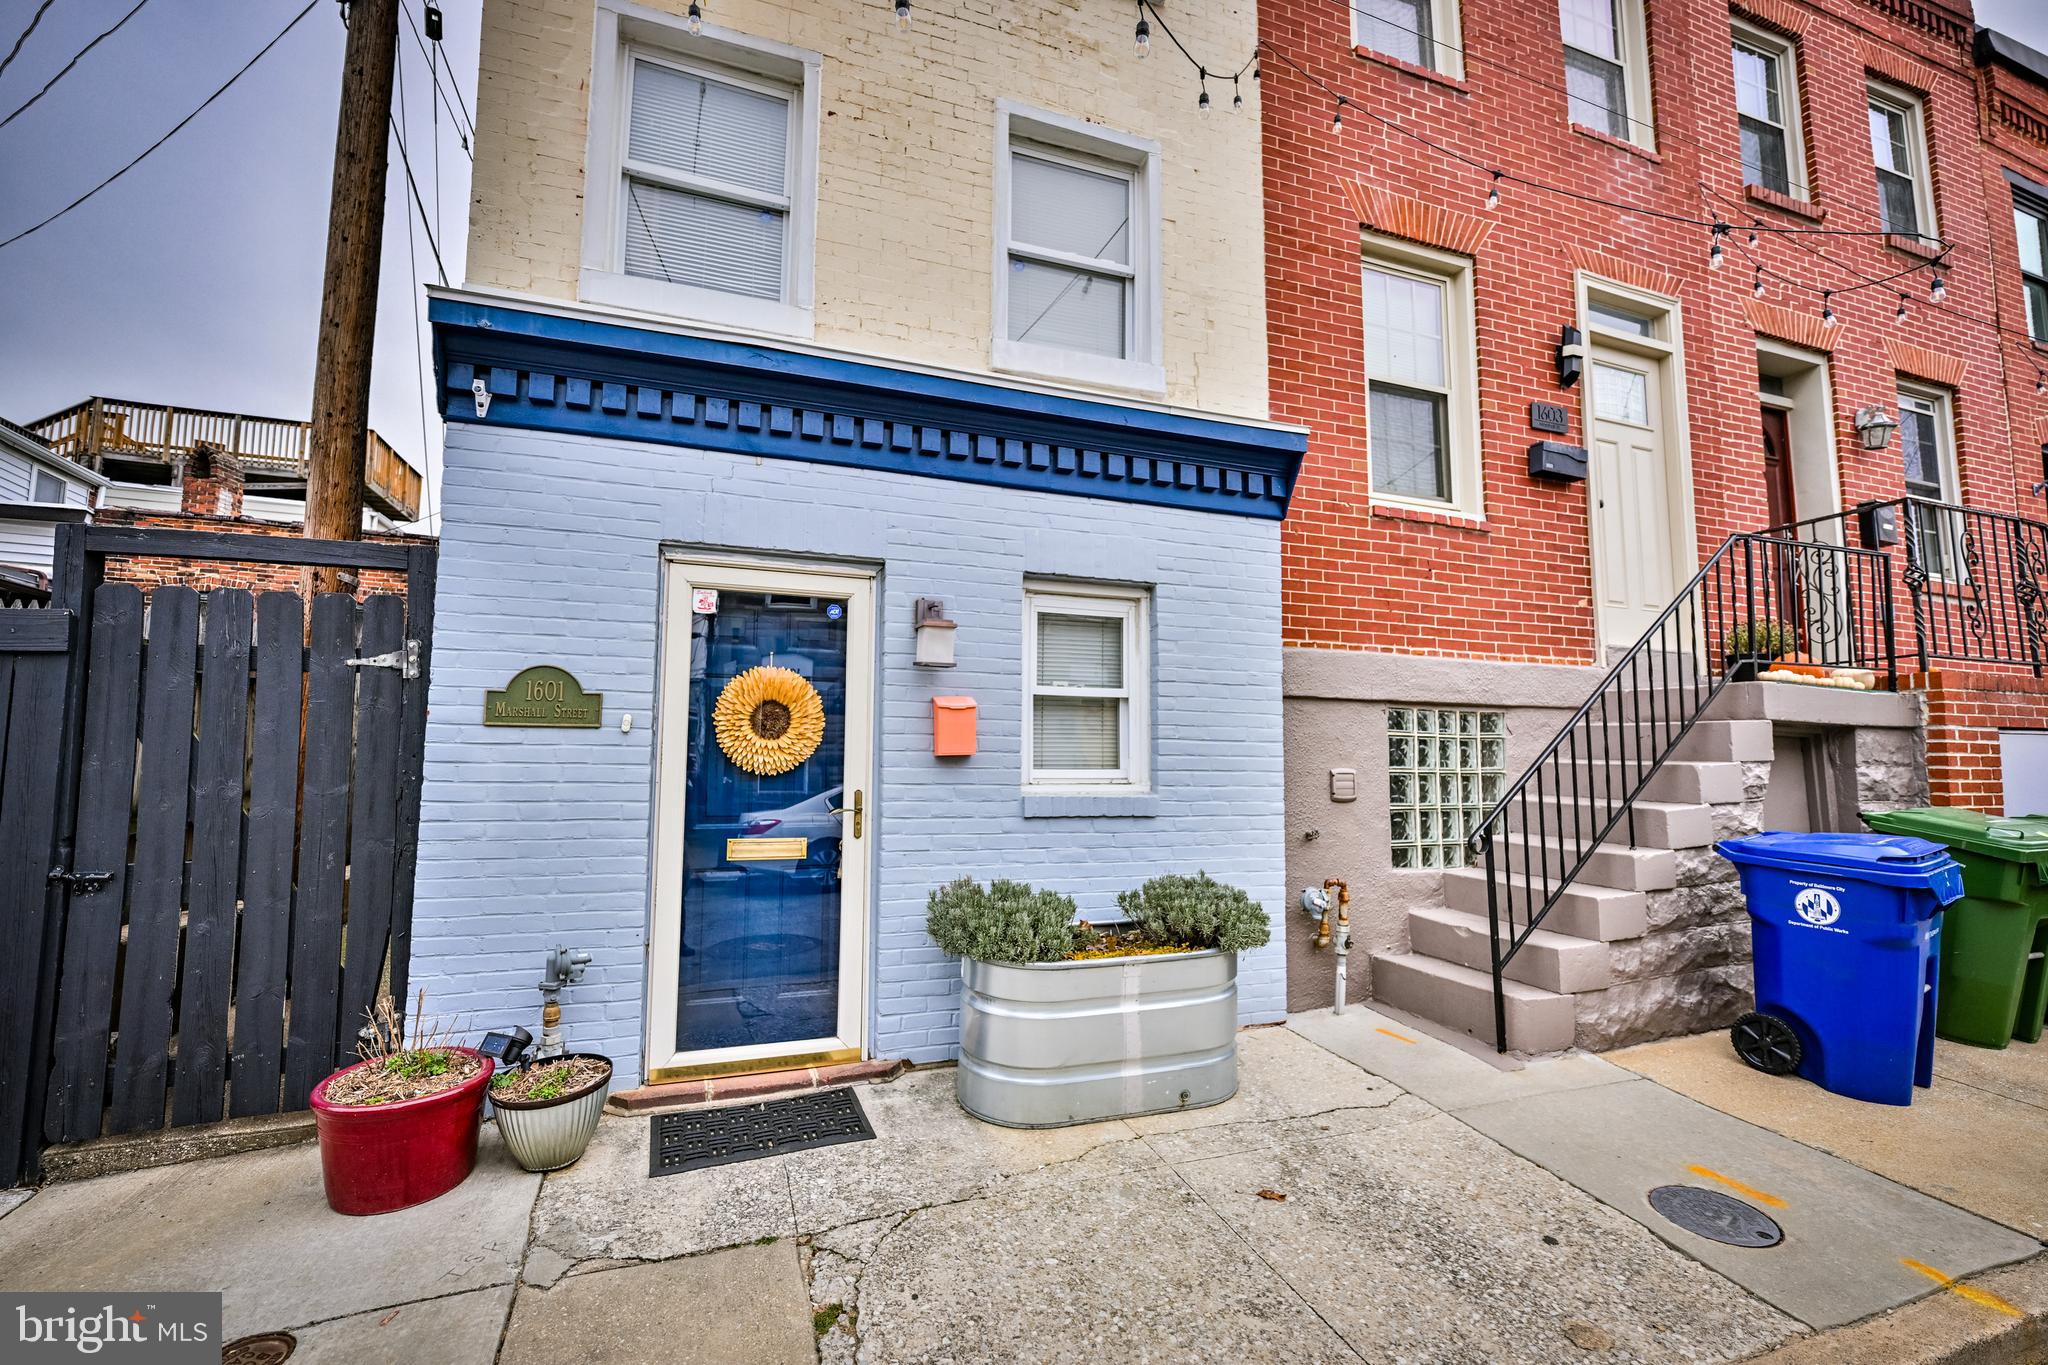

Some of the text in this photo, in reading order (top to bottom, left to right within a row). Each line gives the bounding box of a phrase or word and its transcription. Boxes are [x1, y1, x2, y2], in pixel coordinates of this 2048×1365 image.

[1537, 404, 1563, 423] 1603
[526, 680, 565, 702] 1601
[495, 701, 589, 720] MARSHALL STREET
[1789, 879, 1808, 888] Property
[1814, 882, 1835, 891] Baltimore
[1788, 919, 1813, 929] Department
